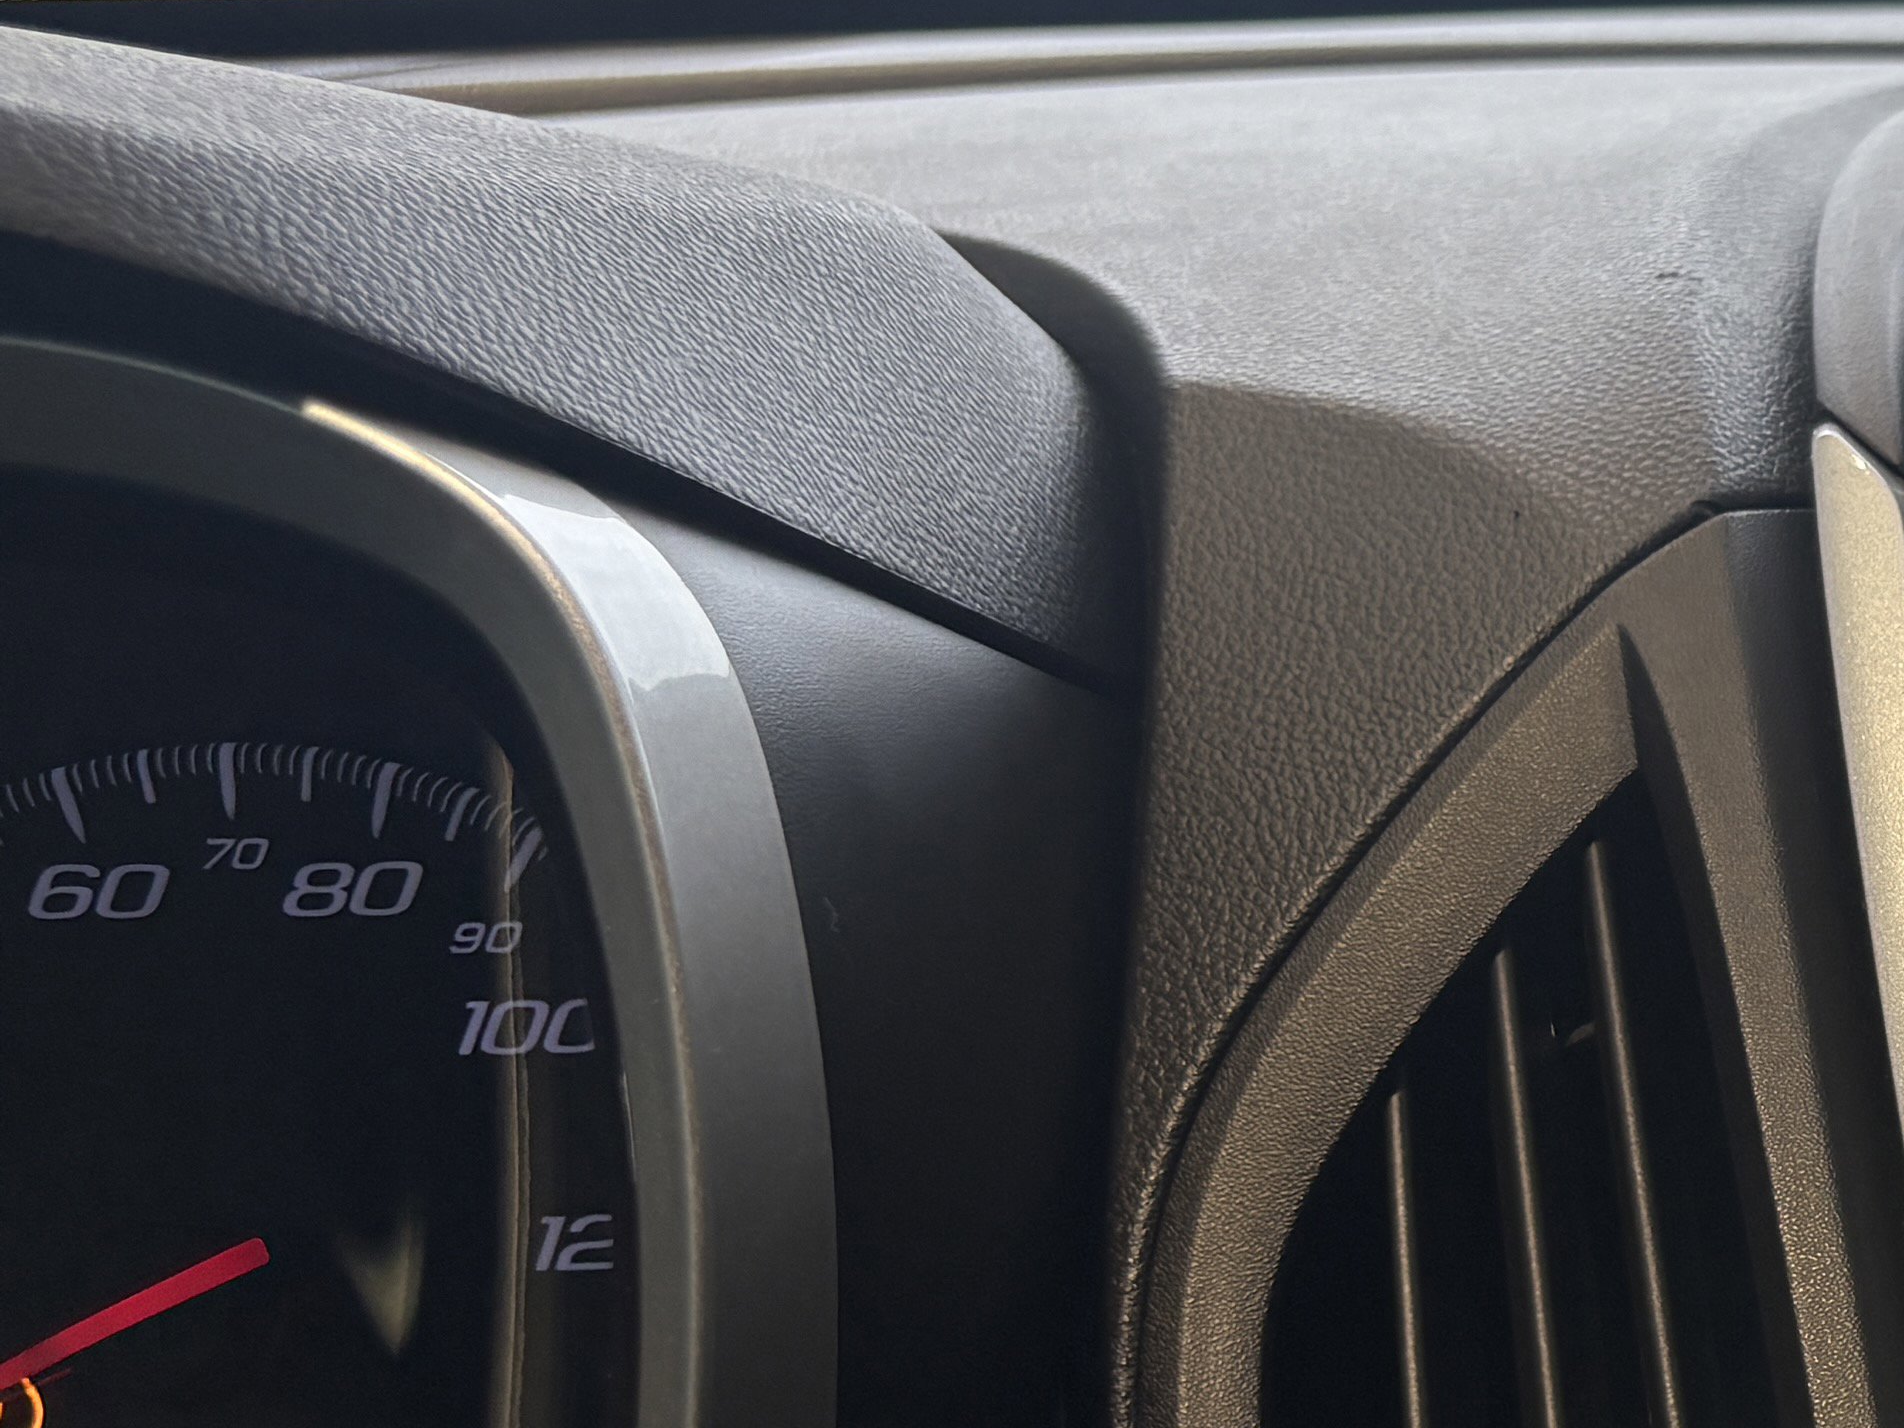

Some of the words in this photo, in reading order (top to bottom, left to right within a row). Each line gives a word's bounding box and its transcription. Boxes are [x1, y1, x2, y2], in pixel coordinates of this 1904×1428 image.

[201, 837, 270, 872] 70
[27, 863, 171, 920] 60
[281, 861, 424, 919] 80
[449, 921, 523, 953] 90
